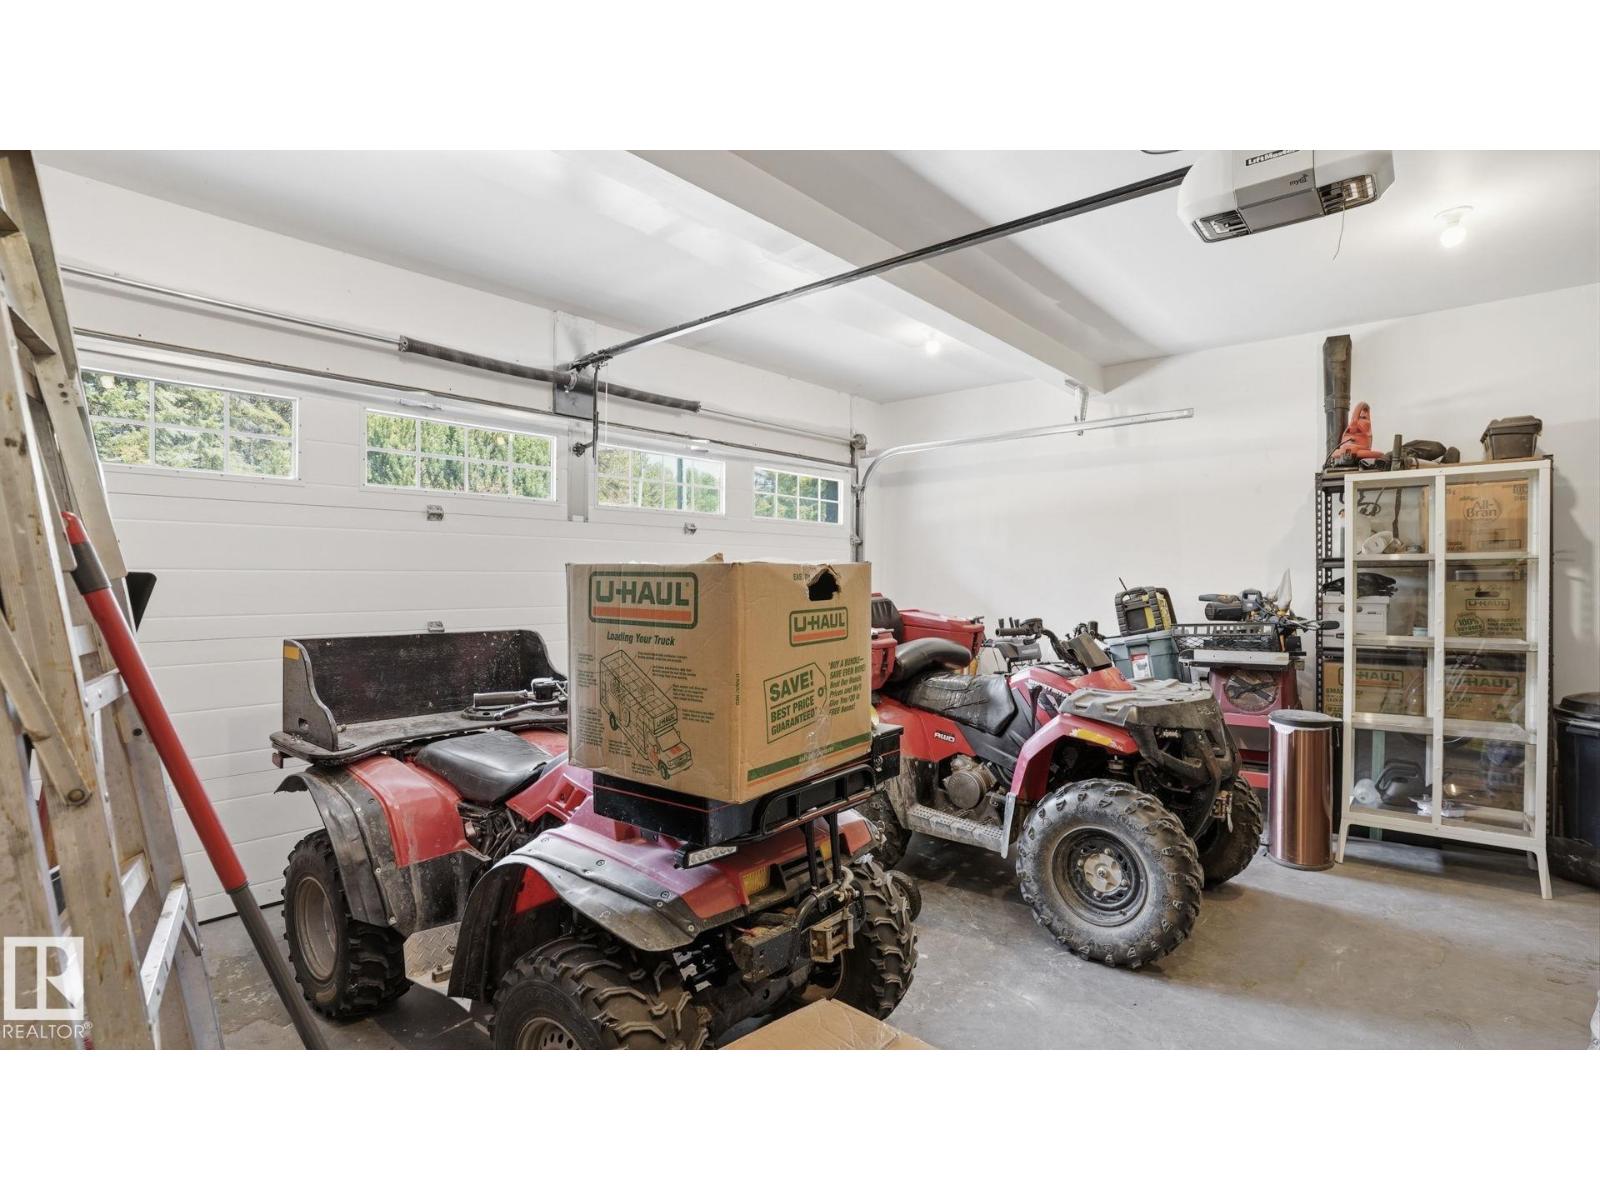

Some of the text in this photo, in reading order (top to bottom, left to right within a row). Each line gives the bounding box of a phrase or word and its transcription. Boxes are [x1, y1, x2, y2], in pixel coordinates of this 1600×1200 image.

[1466, 507, 1497, 518] Bran
[595, 580, 690, 606] U-HAUL
[793, 612, 846, 633] U-HAUL
[606, 631, 676, 647] Loading Your Truck
[769, 669, 814, 702] SAVE!
[770, 695, 815, 724] BEST PRICE
[934, 731, 955, 743] AWD
